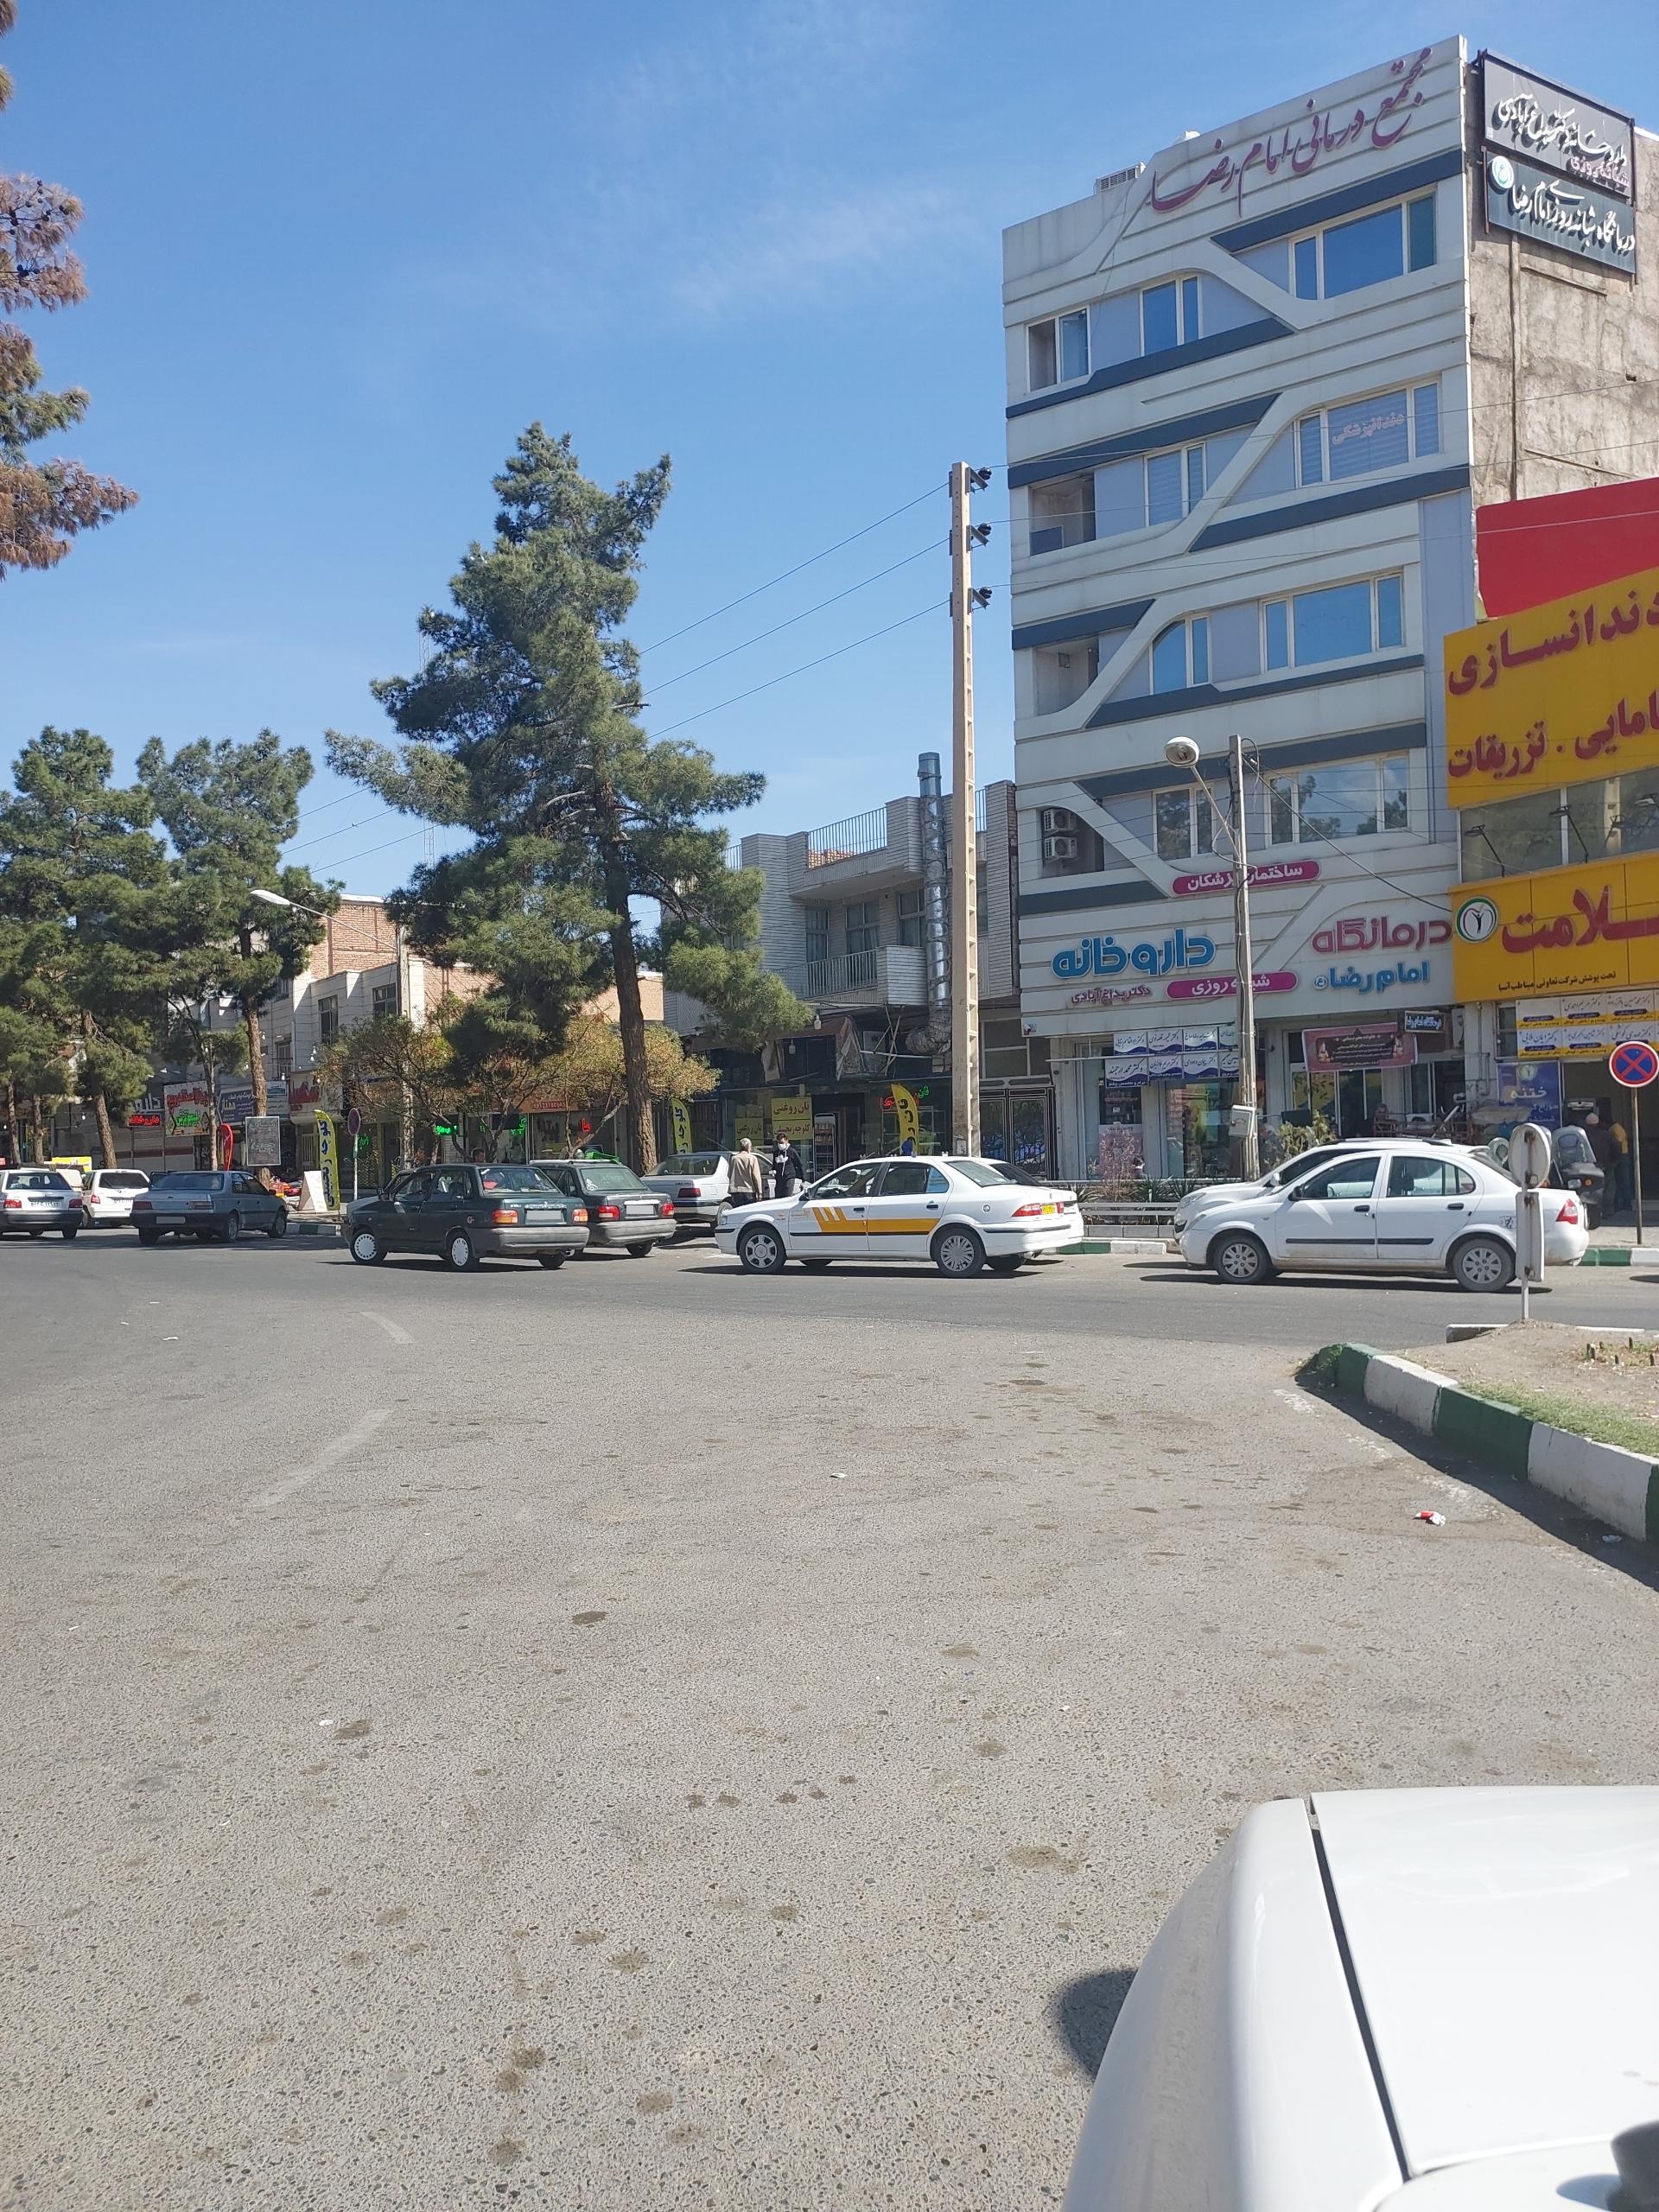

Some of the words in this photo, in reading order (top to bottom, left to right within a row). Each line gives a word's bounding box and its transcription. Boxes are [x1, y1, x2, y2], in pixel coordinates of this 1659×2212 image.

[1370, 48, 1432, 149] مجتمع
[1292, 99, 1366, 175] درمانی
[1562, 122, 1628, 167] داروخانه
[1151, 138, 1236, 213] رضا
[1236, 126, 1291, 219] امام
[1513, 184, 1534, 214] رضا
[1597, 210, 1635, 251] درمانگاه
[1332, 412, 1405, 444] دندانپزشکی
[1575, 690, 1659, 760] امایی
[1448, 720, 1546, 779] تزریقات
[1187, 871, 1235, 891] زشکان
[1312, 915, 1452, 953] درمانگاه
[1052, 926, 1216, 978] داروخانه
[1125, 984, 1151, 1001] دکتر
[1191, 979, 1229, 996] روزی
[1329, 965, 1373, 995] رضا
[1376, 961, 1430, 994] امام
[773, 1102, 798, 1116] روغنی
[797, 1101, 810, 1115] نان
[1510, 1085, 1548, 1100] ختنه
